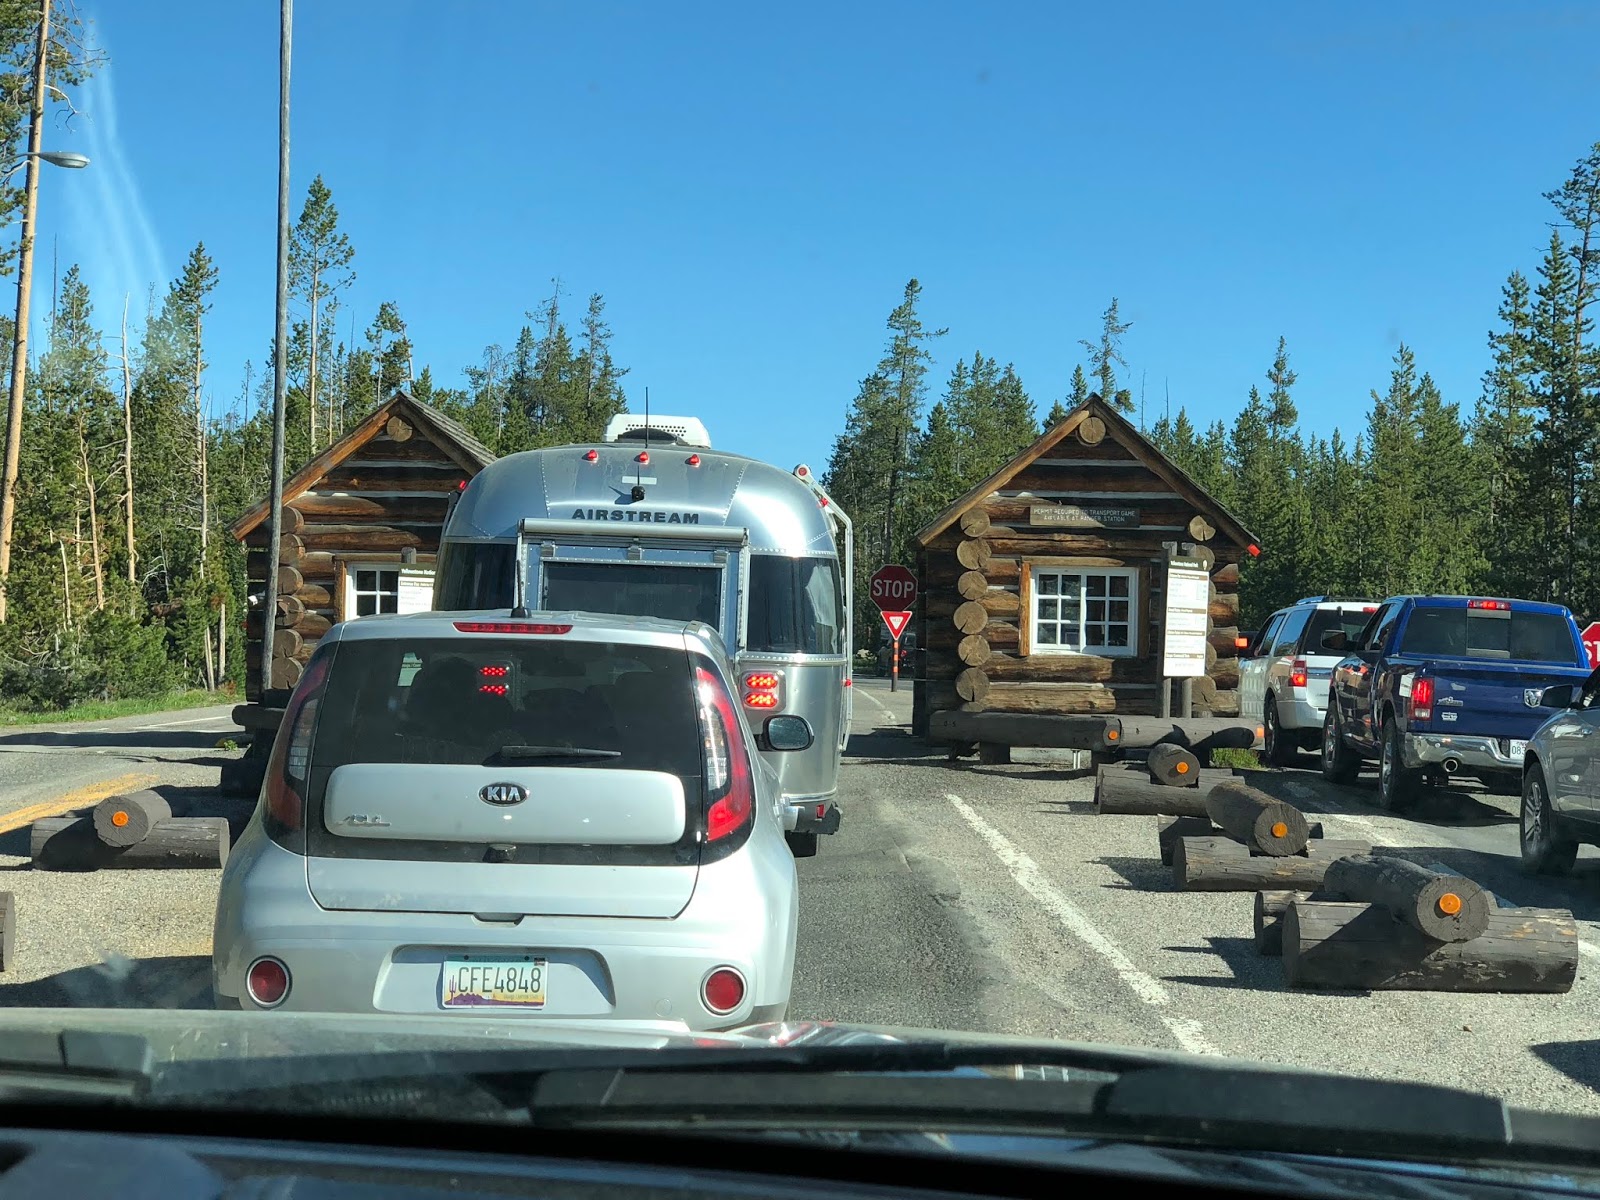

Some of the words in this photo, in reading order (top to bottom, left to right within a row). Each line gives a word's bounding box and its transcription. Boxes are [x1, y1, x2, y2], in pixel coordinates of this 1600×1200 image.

[571, 508, 699, 525] AIRSTREAM
[872, 579, 915, 599] STOP
[487, 786, 521, 802] KIA
[458, 966, 542, 993] CFE4848
